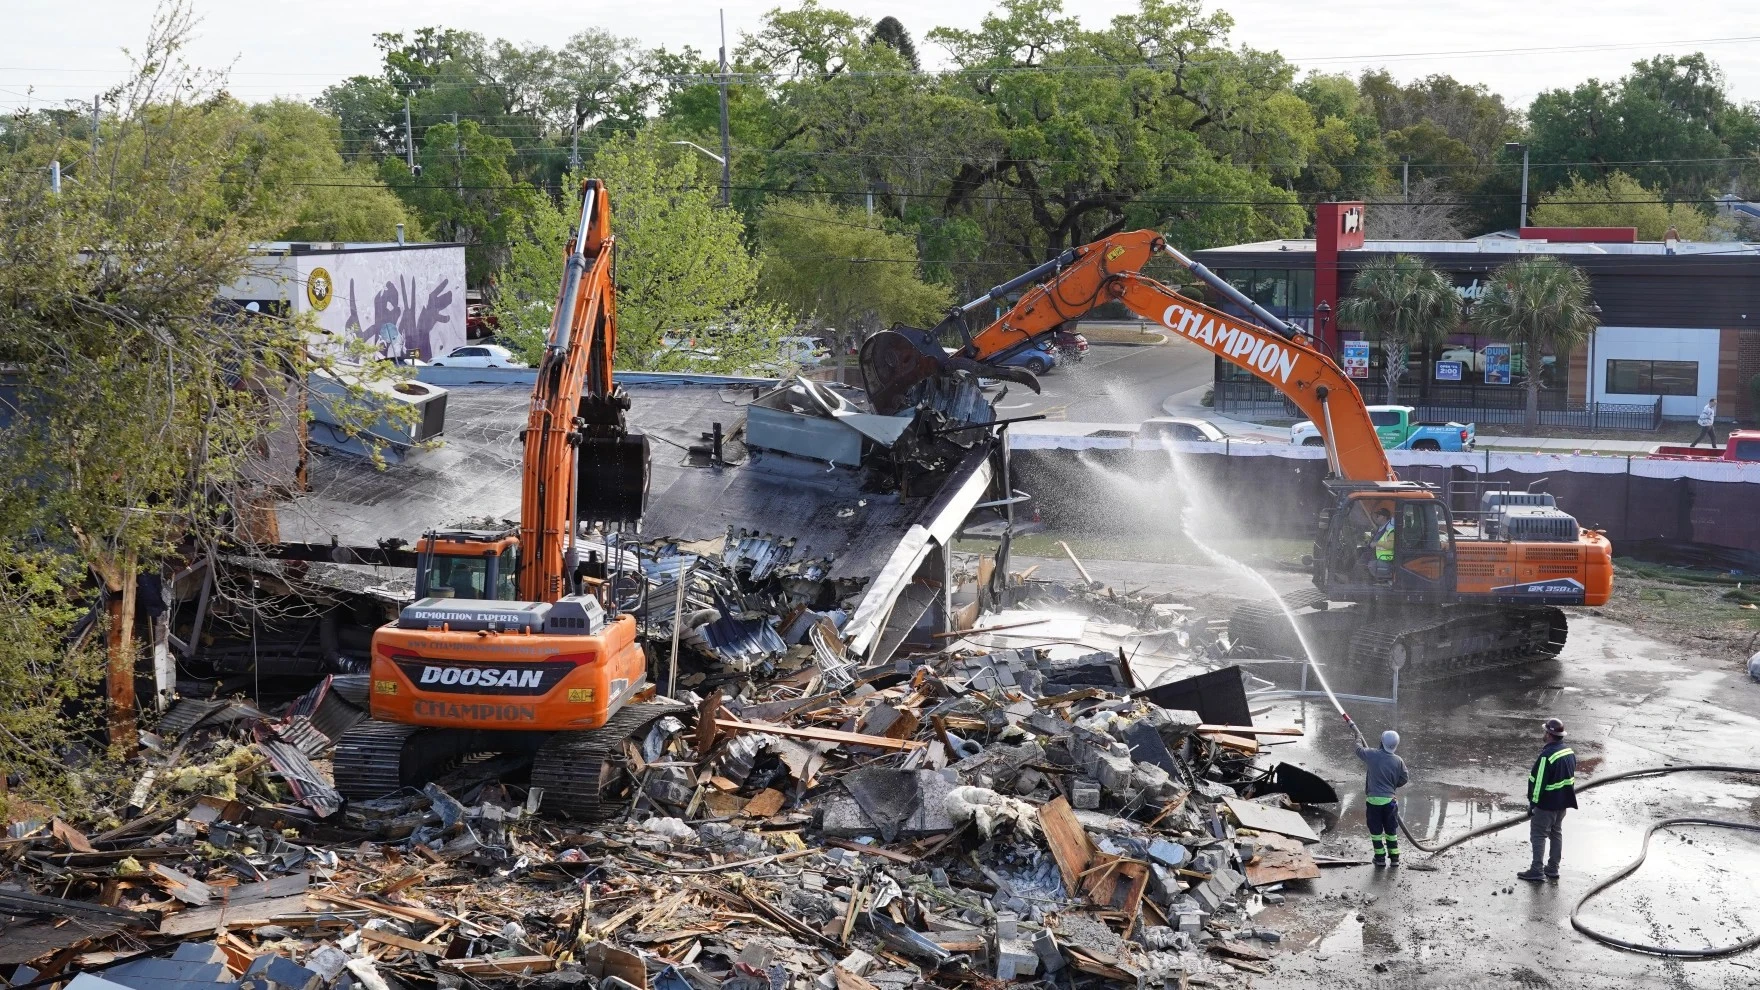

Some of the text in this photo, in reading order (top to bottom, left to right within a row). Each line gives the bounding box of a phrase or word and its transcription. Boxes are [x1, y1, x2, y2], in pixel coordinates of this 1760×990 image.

[1162, 304, 1300, 384] CHAMPION
[1487, 364, 1509, 372] HOME
[415, 611, 519, 622] DEMOLITION EXPERTS
[420, 666, 544, 688] DOOSAN
[415, 701, 535, 721] CHAMPION
